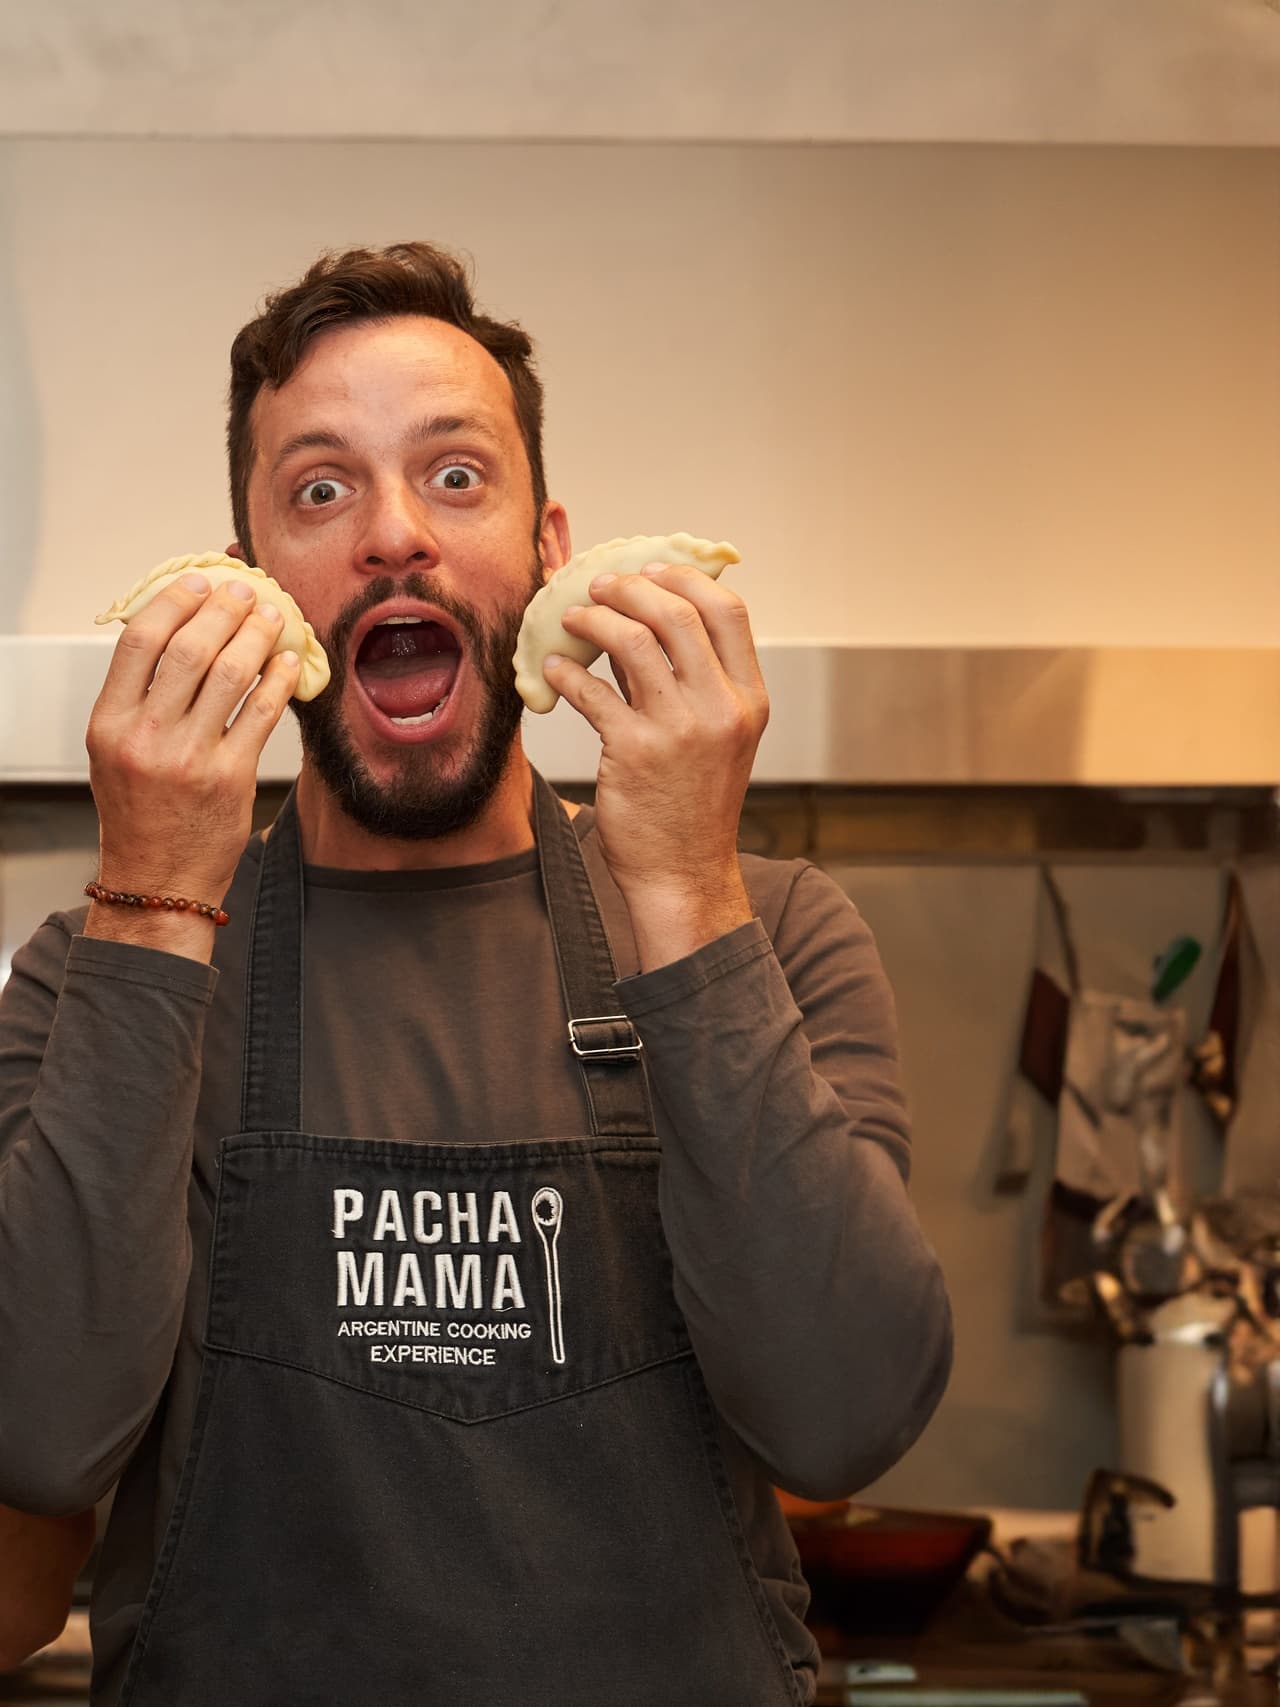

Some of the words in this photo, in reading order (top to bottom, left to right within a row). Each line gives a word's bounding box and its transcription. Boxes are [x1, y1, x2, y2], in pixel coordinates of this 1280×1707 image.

[331, 1188, 521, 1244] PACHA
[336, 1251, 526, 1310] MAMA
[337, 1320, 441, 1338] ARGENTINE
[446, 1322, 532, 1340] COOKING
[370, 1345, 497, 1366] EXPERIENCE
